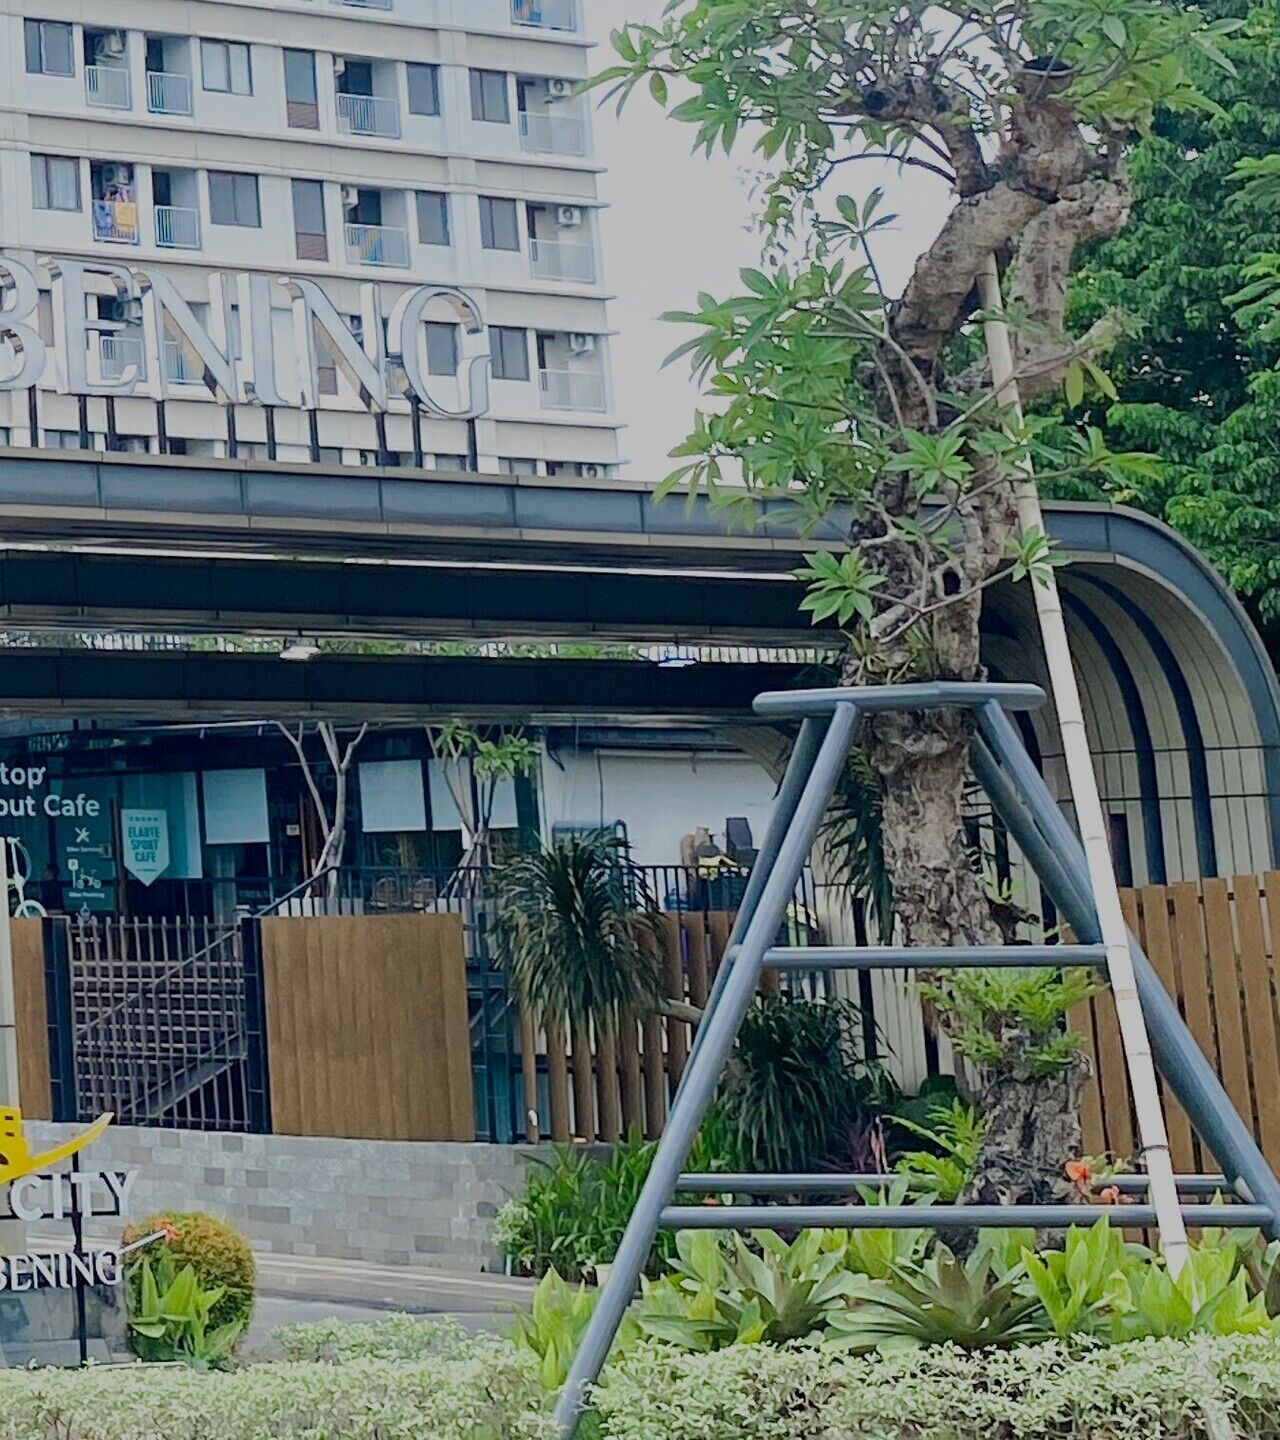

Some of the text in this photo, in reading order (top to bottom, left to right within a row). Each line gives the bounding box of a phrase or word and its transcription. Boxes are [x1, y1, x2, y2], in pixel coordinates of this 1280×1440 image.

[43, 793, 100, 817] Cafe
[135, 851, 157, 863] CAFE
[10, 1169, 139, 1222] CITY
